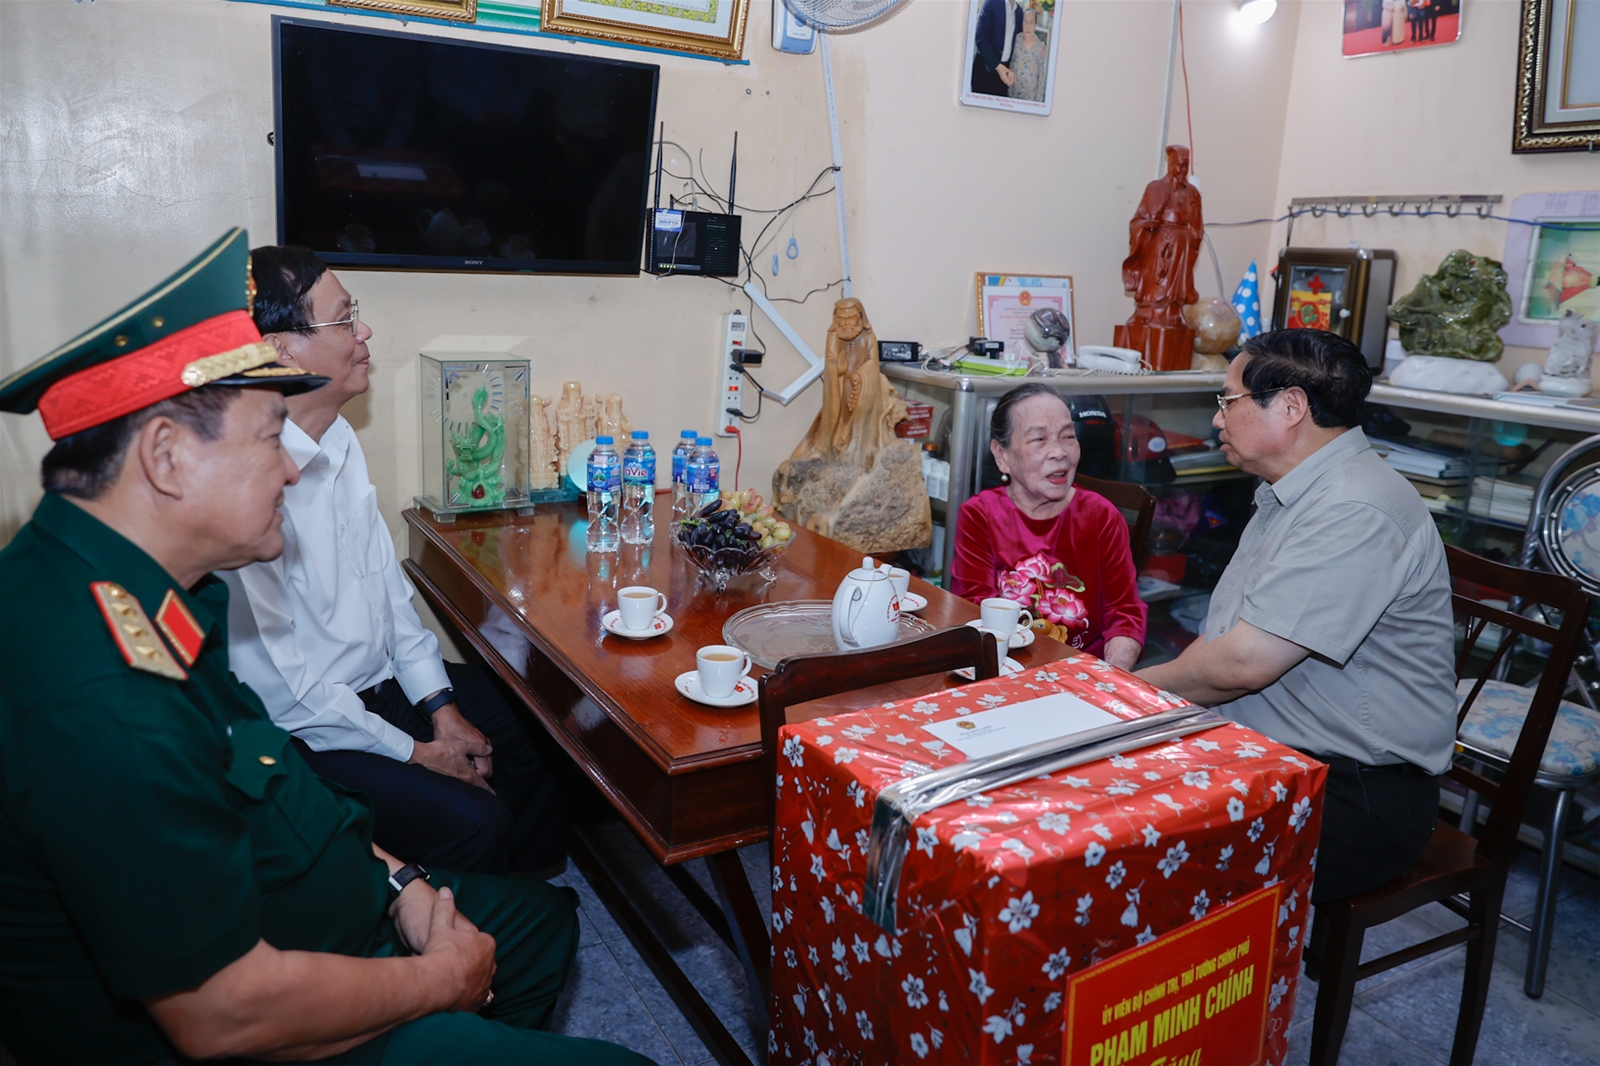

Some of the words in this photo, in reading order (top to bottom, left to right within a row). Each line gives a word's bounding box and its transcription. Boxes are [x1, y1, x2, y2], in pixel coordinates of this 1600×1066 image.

[624, 467, 648, 476] aVie
[1113, 998, 1132, 1020] VIÊN
[1132, 990, 1143, 1012] BỘ
[1152, 993, 1202, 1048] MINH
[1205, 963, 1255, 1019] CHÍNH
